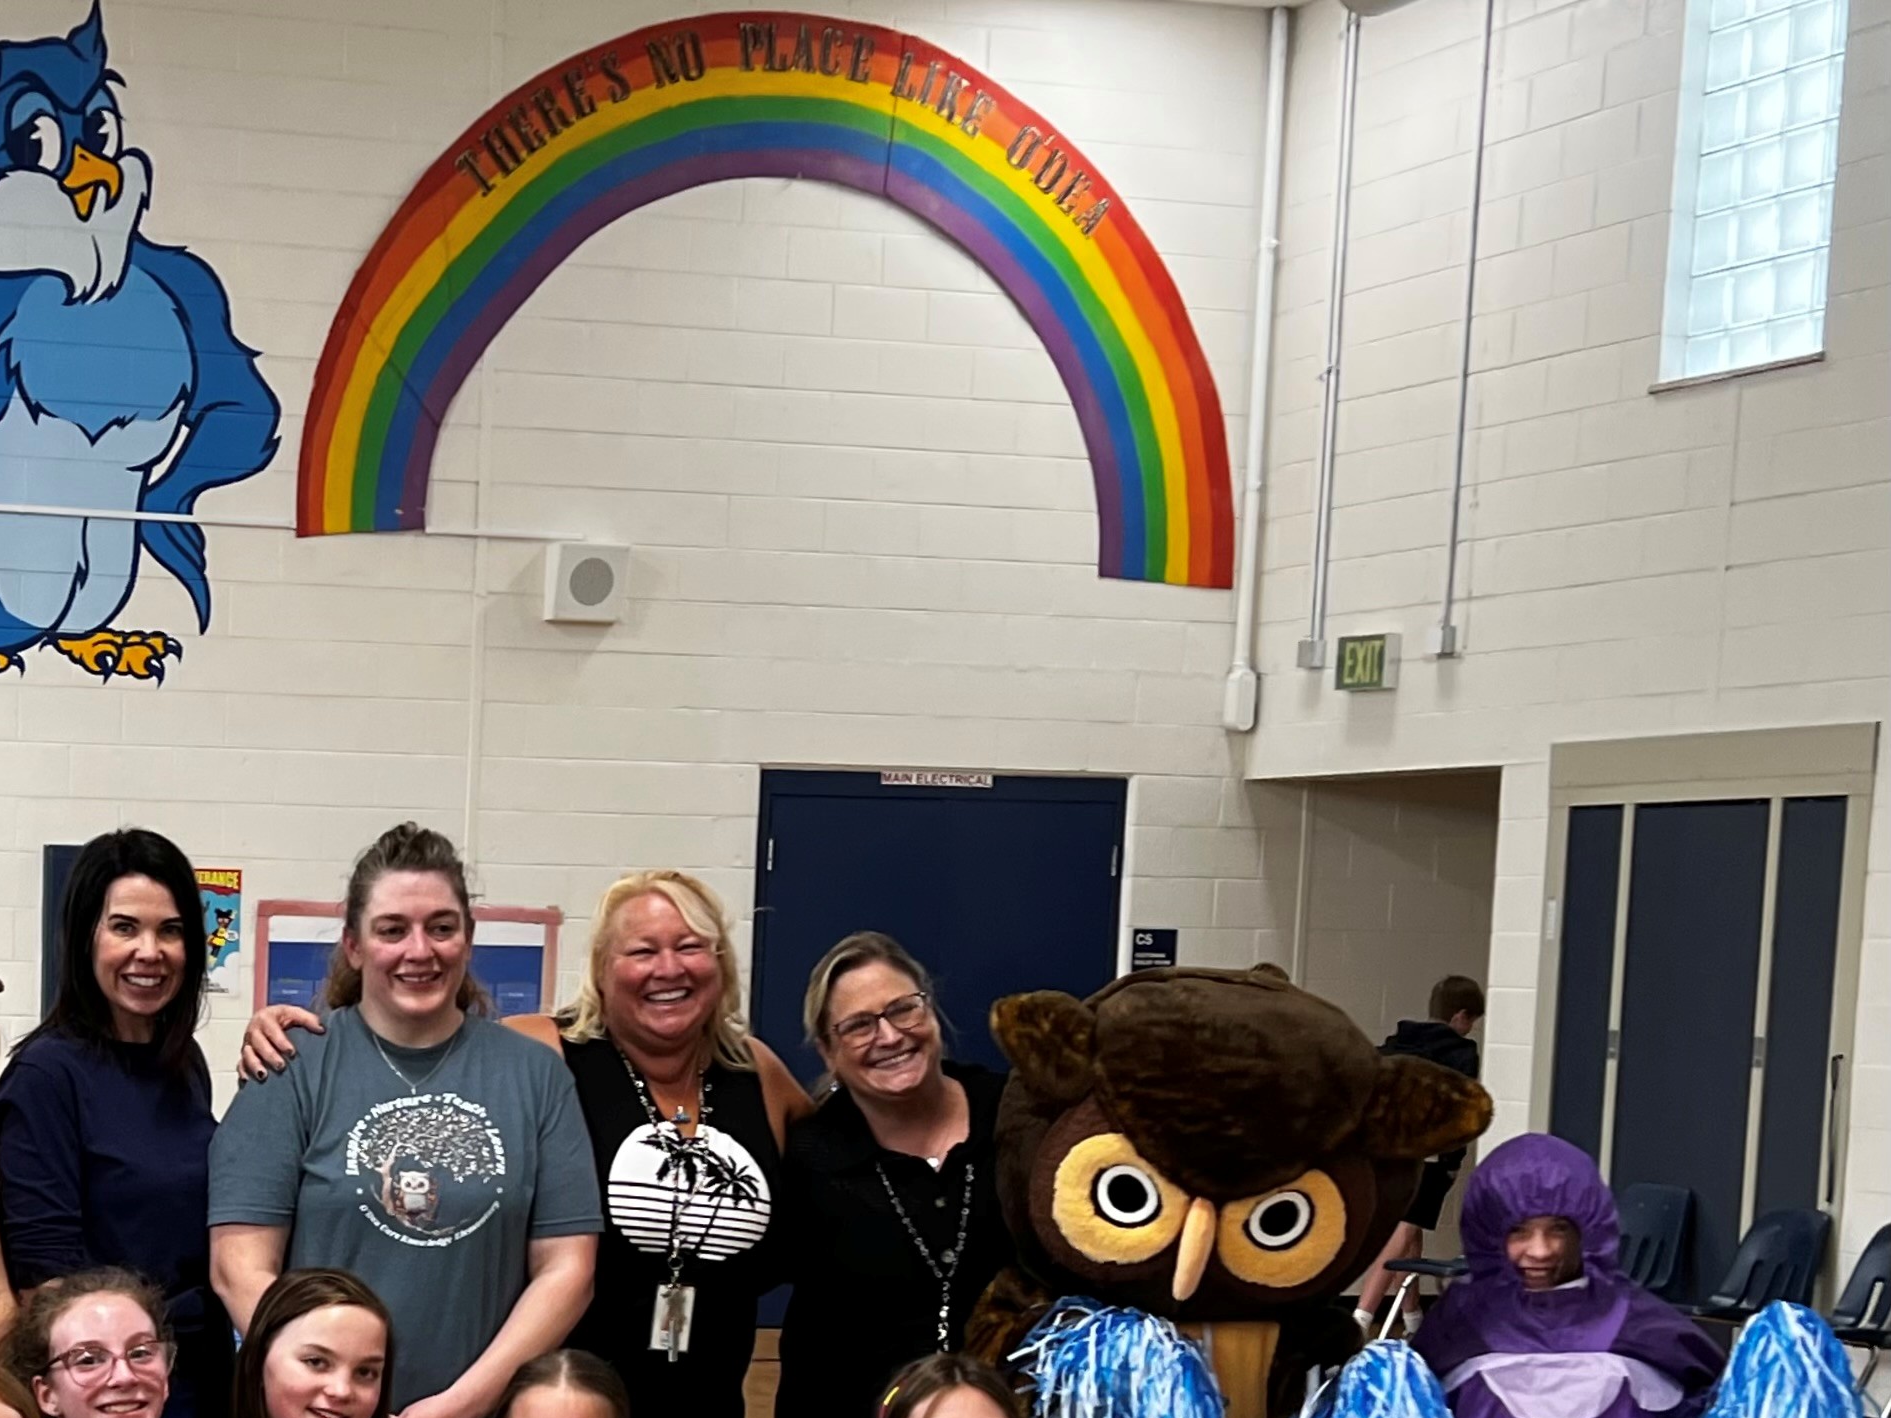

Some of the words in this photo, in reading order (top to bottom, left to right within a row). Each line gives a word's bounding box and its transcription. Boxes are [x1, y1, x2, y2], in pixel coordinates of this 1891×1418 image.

[455, 53, 631, 197] THERE'S
[646, 29, 706, 89] NO
[738, 22, 875, 84] PLACE
[890, 51, 997, 138] LIKE
[1006, 124, 1110, 239] O'DEA
[1343, 640, 1384, 684] EXIT
[883, 772, 913, 783] MAIN
[916, 773, 990, 785] ELECTRICAL
[194, 871, 239, 889] ERANCE
[370, 1094, 432, 1118] Nurture
[485, 1127, 506, 1175] Learn
